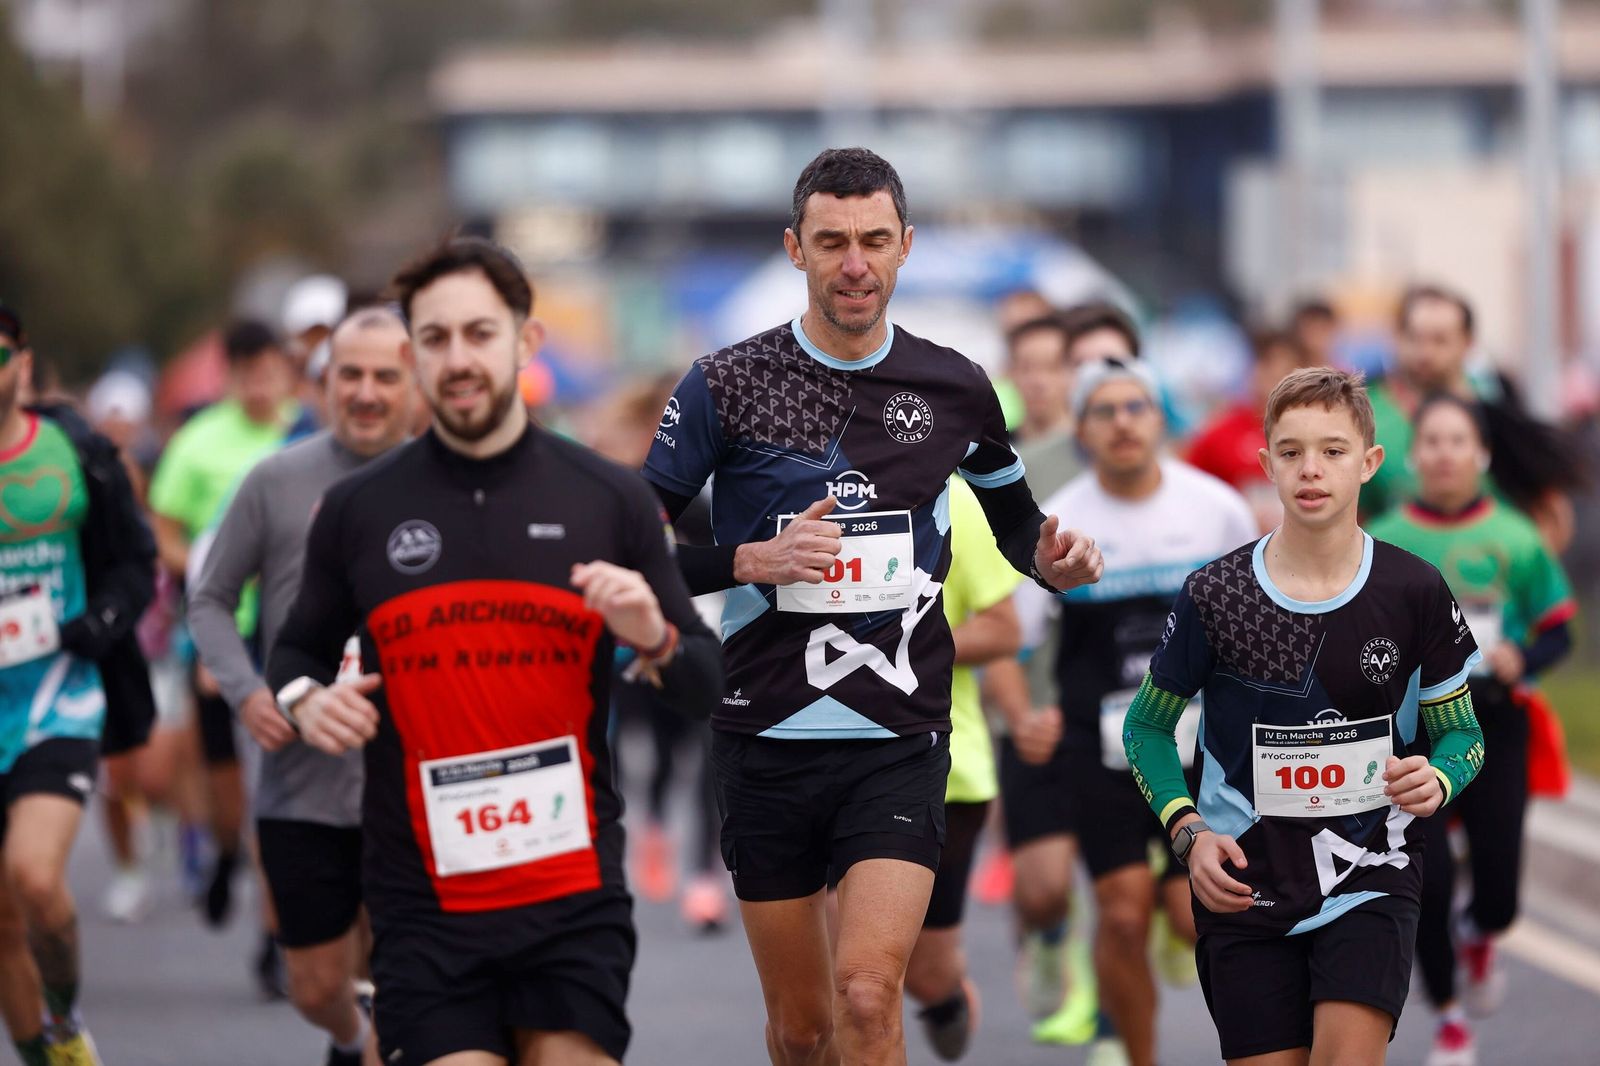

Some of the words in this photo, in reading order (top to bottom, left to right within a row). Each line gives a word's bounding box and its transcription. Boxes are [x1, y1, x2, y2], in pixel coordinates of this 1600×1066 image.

[664, 404, 681, 425] PM
[886, 394, 931, 426] TRAZACAMINOS
[896, 432, 923, 441] CLUB
[826, 481, 878, 499] HPM
[851, 521, 878, 532] 2026
[822, 557, 862, 583] 01
[1362, 639, 1398, 670] TRAZACAMINOS
[1265, 731, 1274, 739] IV
[1276, 732, 1288, 740] En
[1289, 731, 1324, 740] Marcha
[1329, 729, 1358, 741] 2026
[1261, 752, 1320, 760] #YoCorroPor
[1275, 764, 1345, 790] 100
[456, 799, 533, 836] 164
